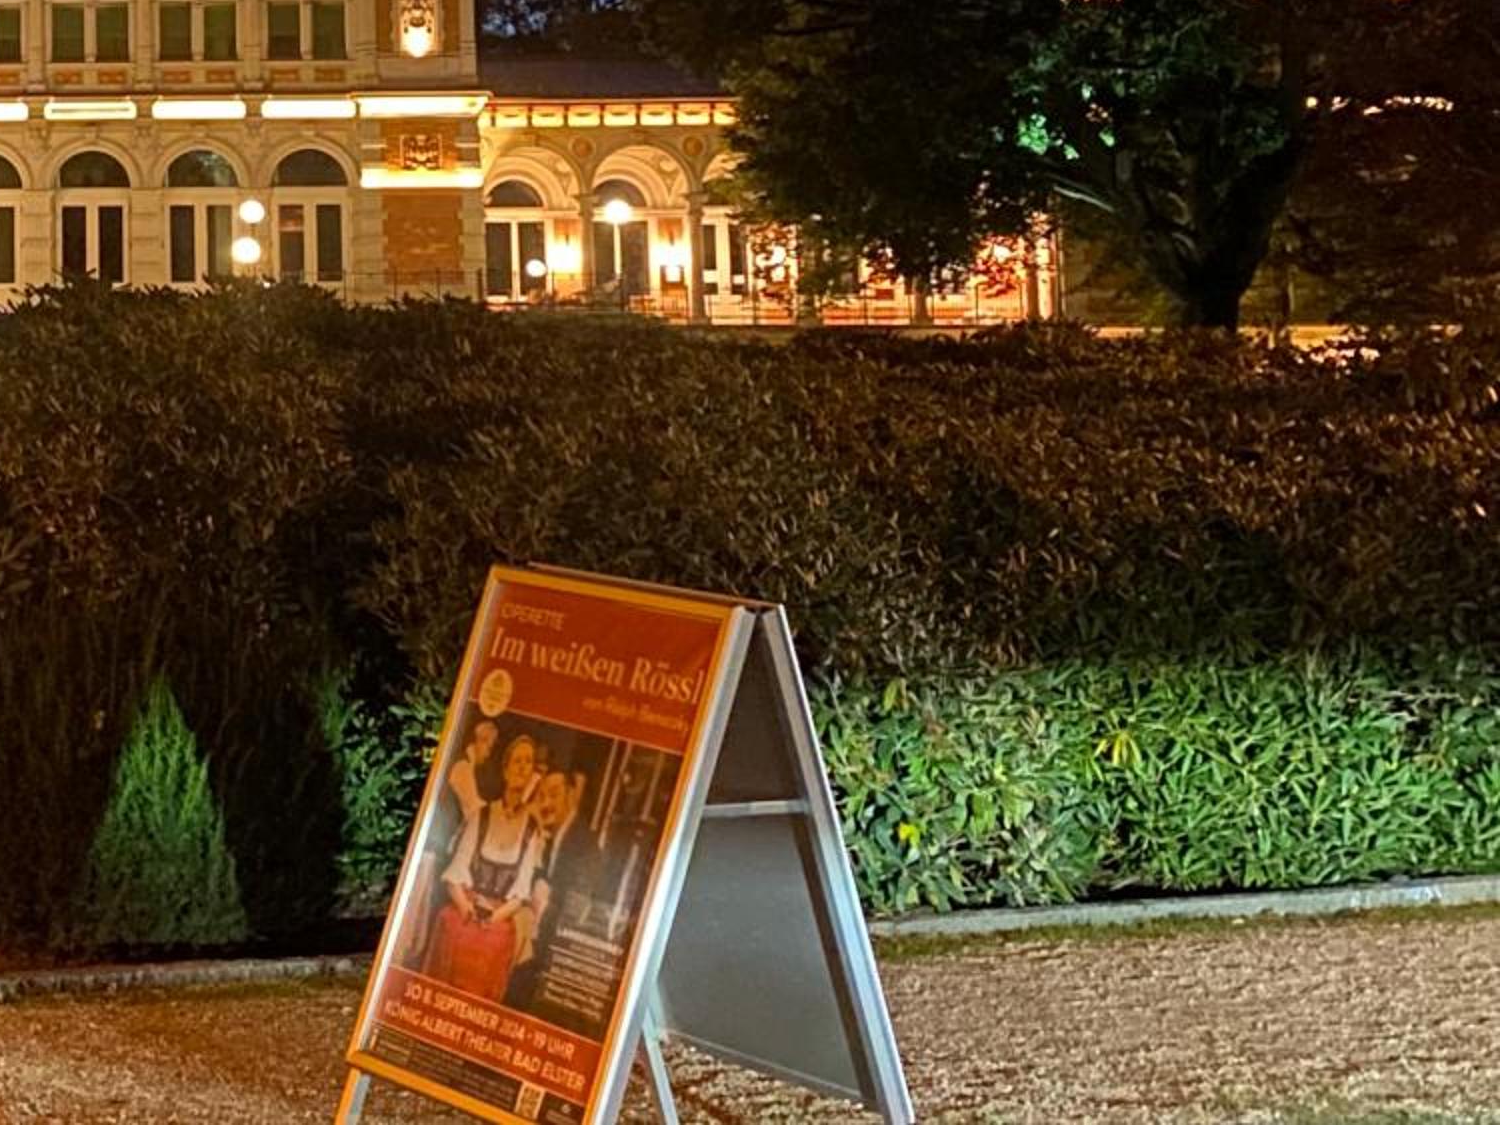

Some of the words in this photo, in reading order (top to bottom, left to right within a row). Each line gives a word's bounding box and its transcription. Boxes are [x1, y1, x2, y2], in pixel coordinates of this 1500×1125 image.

[490, 627, 525, 663] Im
[531, 642, 624, 686] weißen
[630, 657, 704, 705] Rössl
[512, 1049, 541, 1073] BAD
